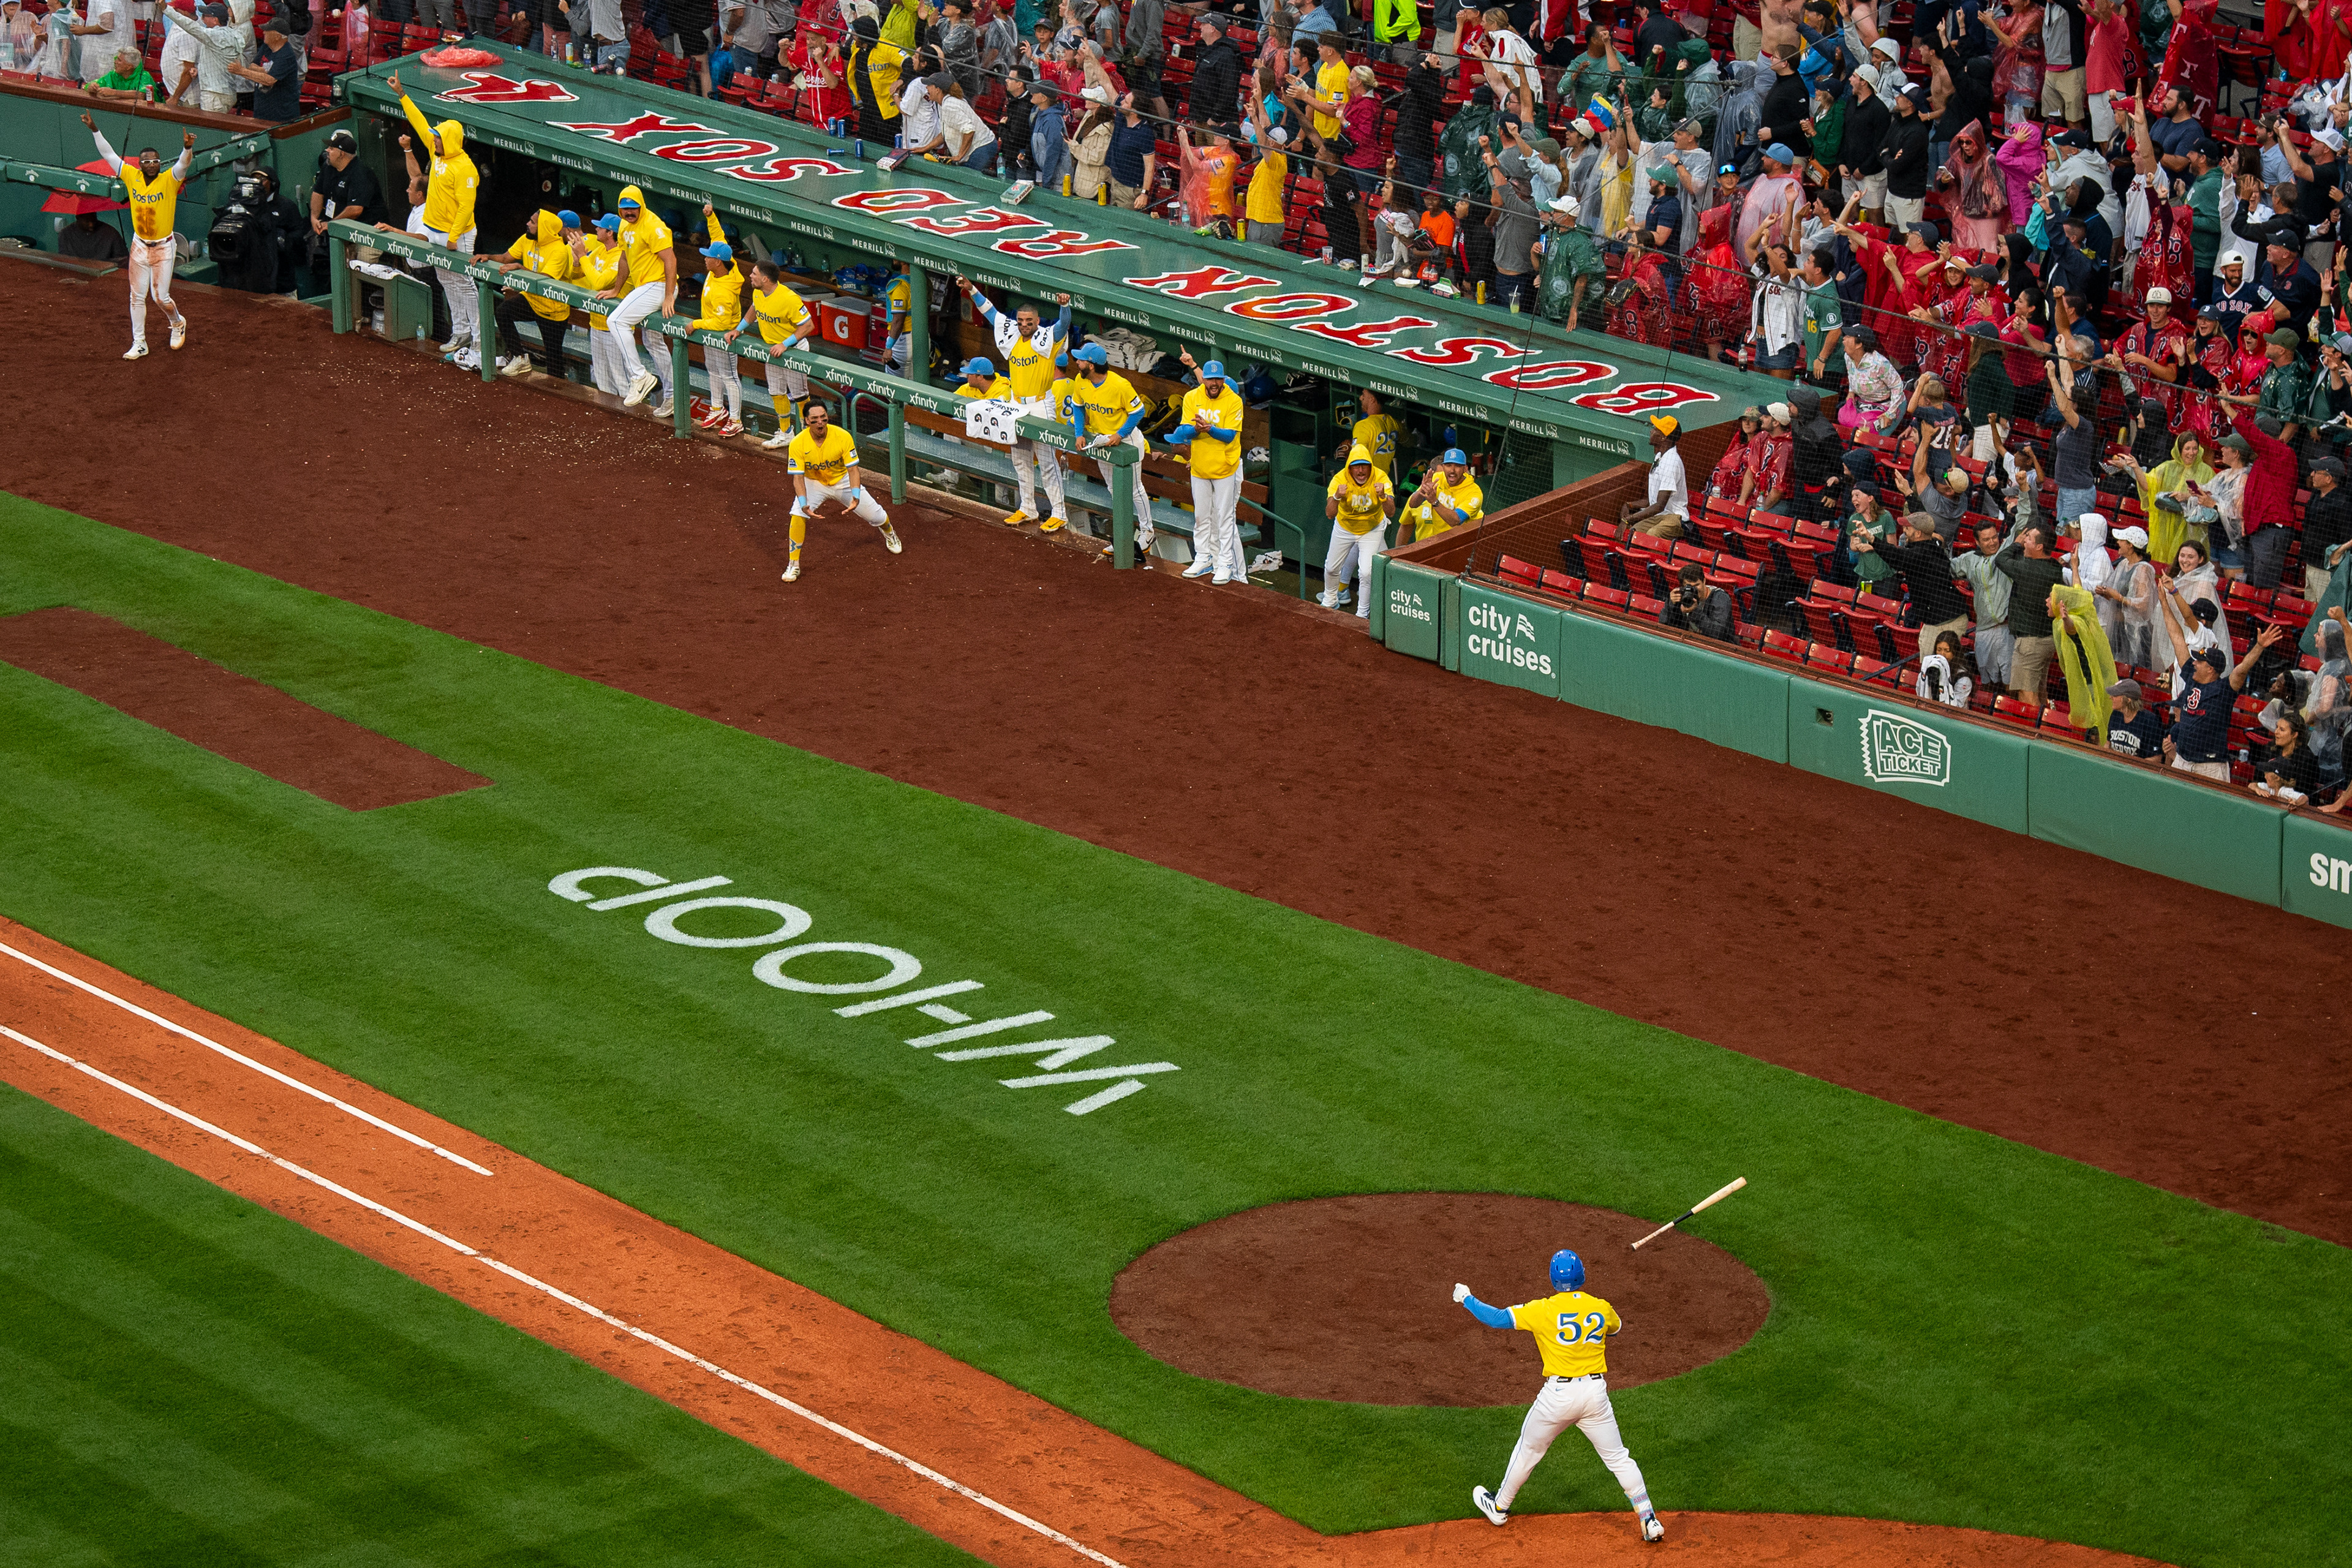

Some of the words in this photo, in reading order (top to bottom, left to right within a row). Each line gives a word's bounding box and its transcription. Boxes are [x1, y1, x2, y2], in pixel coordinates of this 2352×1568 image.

[867, 62, 891, 73] ston
[380, 104, 407, 118] MERRIL
[494, 137, 524, 153] MERRILL
[545, 109, 864, 182] SOX
[552, 154, 582, 169] MERRILL
[611, 170, 641, 186] MERRILL
[132, 187, 164, 205] Boston
[670, 187, 701, 203] MERRILL
[730, 203, 761, 219] MERRILL
[791, 221, 822, 238] MERRILL
[831, 187, 1141, 260] RED
[349, 230, 375, 247] xfinity
[852, 238, 884, 254] MERRILL
[387, 241, 413, 258] xfinity
[426, 252, 452, 270] xfinity
[914, 255, 946, 271] MERRILL
[503, 275, 530, 292] xfinity
[976, 273, 1009, 288] MERRILL
[543, 286, 570, 304] xfinity
[1040, 290, 1072, 306] MERL
[582, 298, 609, 316] xfinity
[1104, 307, 1137, 323] MERRILL
[2229, 300, 2252, 314] SOX
[755, 309, 781, 323] oston
[834, 315, 849, 338] G
[1169, 325, 1202, 341] MERRILL
[1807, 319, 1817, 333] 16
[702, 334, 729, 352] xfinity
[1122, 264, 1721, 416] BOSTON
[742, 345, 771, 362] xfinity
[1235, 343, 1269, 360] MERRILL
[784, 357, 812, 374] xfinity
[1010, 355, 1038, 367] oston
[1302, 361, 1336, 378] MERRILL
[825, 369, 853, 386] xfinity
[867, 380, 895, 399] xfinity
[1370, 380, 1404, 398] MERRILL
[909, 393, 938, 410] xfinity
[1084, 401, 1114, 415] oston
[1439, 399, 1474, 417] MERRILL
[1509, 419, 1544, 435] MERRILL
[1038, 430, 1068, 448] xfinity
[1374, 430, 1398, 455] 23
[1579, 435, 1615, 453] MERRILL
[1085, 446, 1112, 461] finity
[805, 456, 844, 470] Boston
[1390, 589, 1412, 606] city
[1390, 601, 1431, 622] cruises
[1468, 603, 1511, 639] city
[1468, 631, 1552, 676] cruises
[1879, 719, 1942, 762] ACE
[1880, 752, 1941, 777] TICKET
[548, 865, 1182, 1116] WHOOP
[1556, 1312, 1606, 1346] 52
